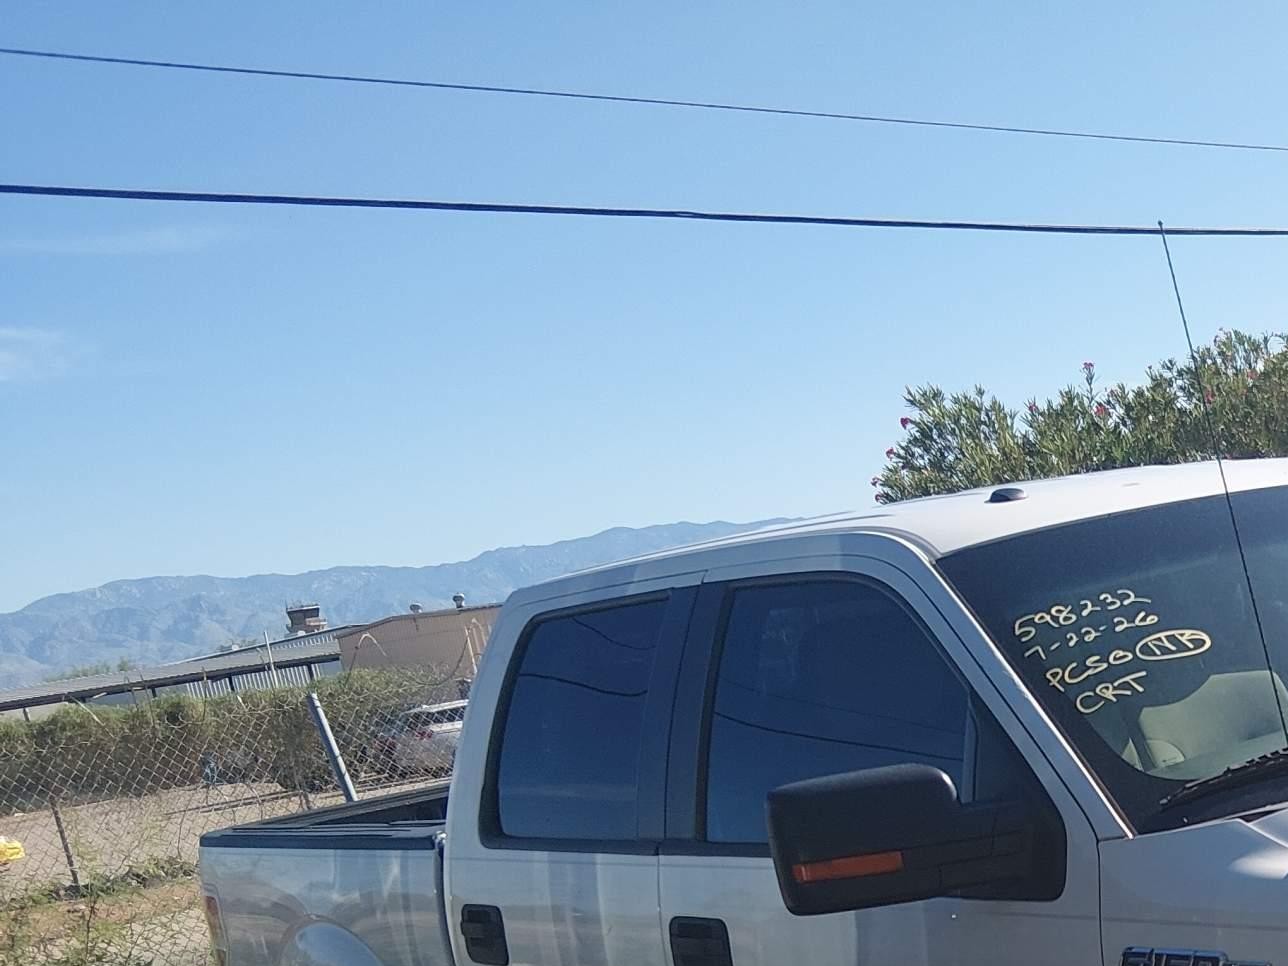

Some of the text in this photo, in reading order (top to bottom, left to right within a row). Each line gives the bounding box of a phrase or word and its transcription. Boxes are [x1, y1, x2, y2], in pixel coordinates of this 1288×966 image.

[1014, 589, 1151, 642] 598232
[1024, 611, 1159, 660] 7-22-26
[1076, 671, 1147, 714] CRT
